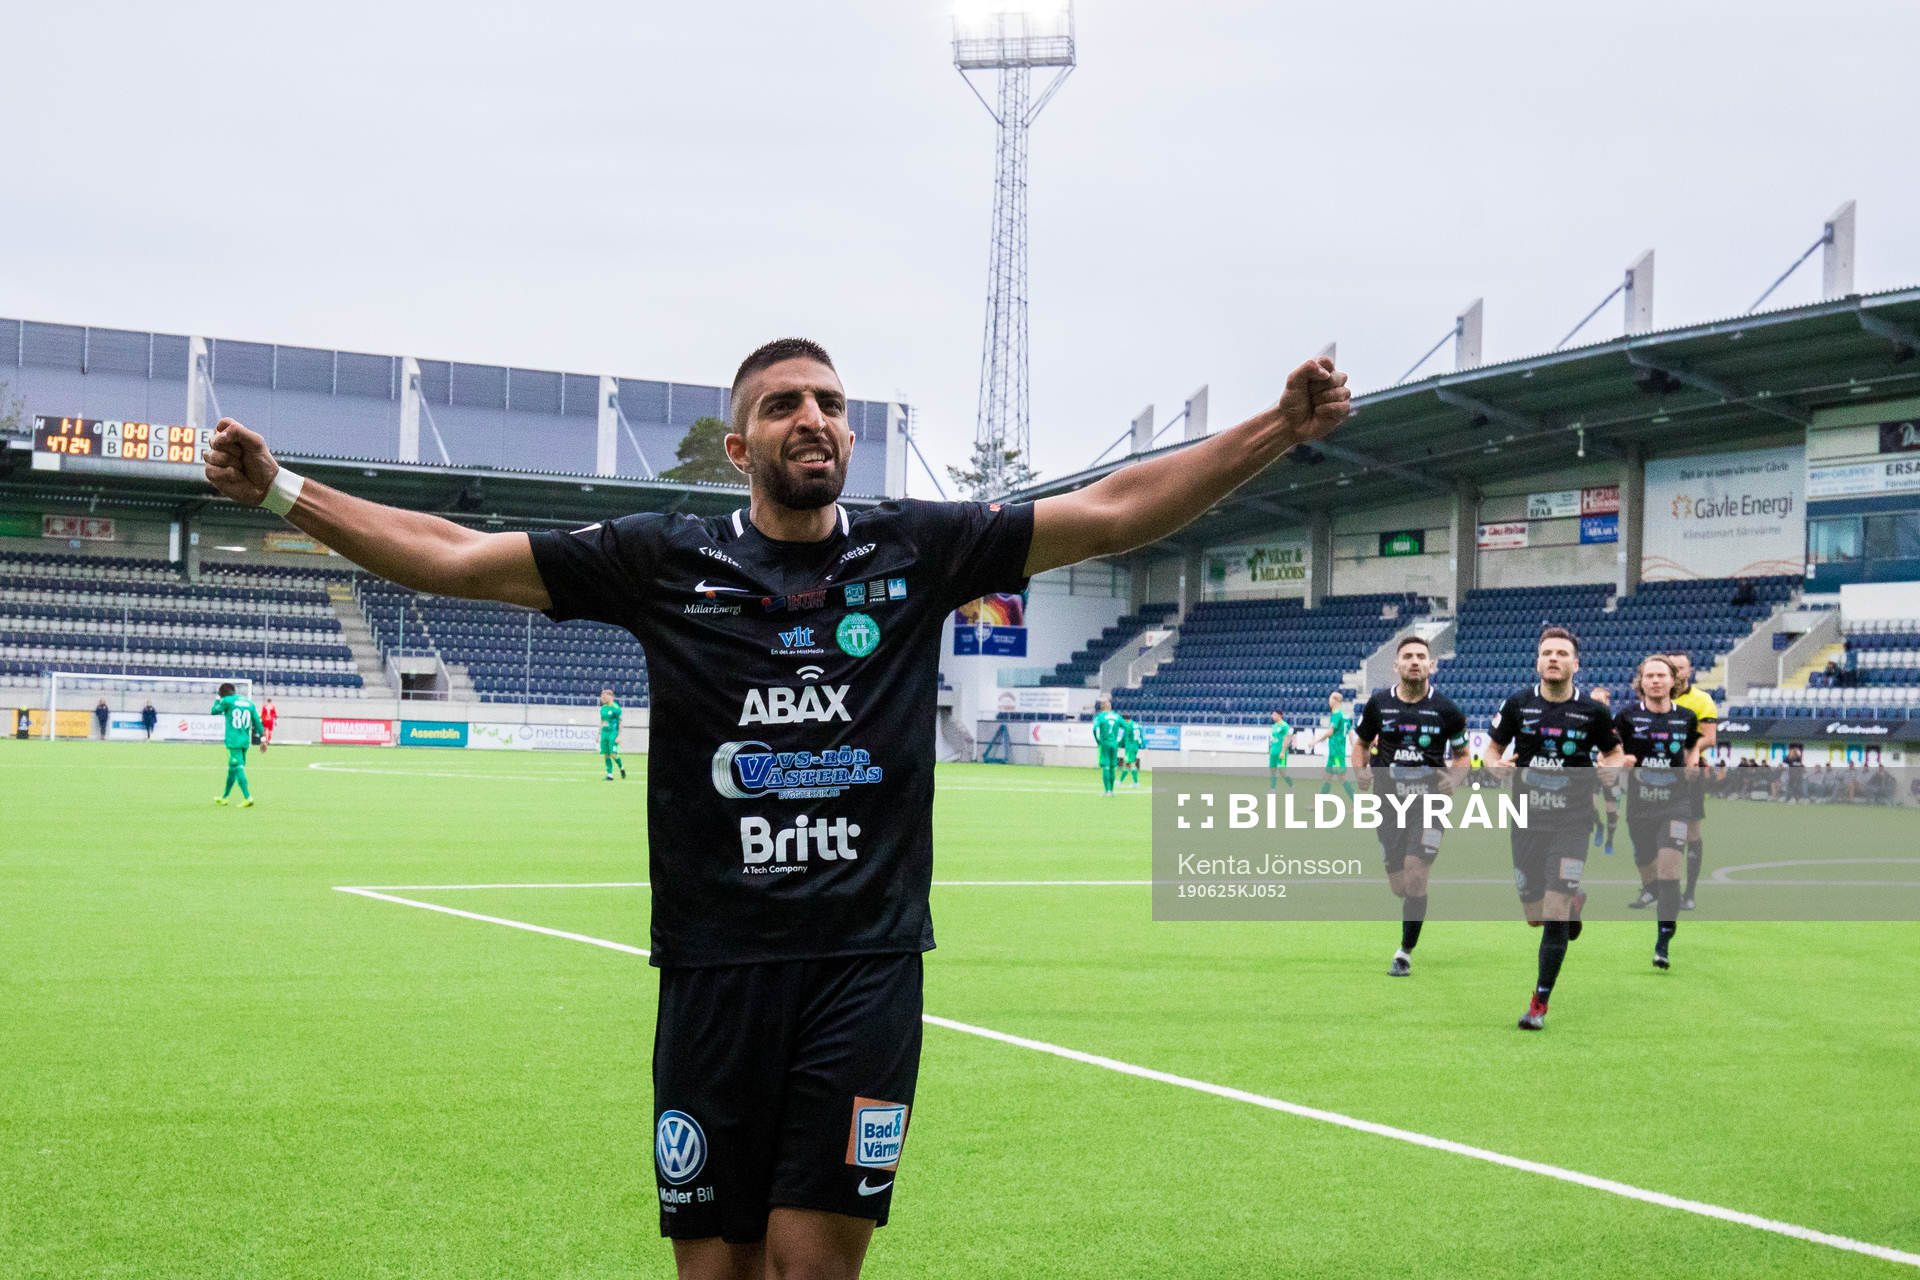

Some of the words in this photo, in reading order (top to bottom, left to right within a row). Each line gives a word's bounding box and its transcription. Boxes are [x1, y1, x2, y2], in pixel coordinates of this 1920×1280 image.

[108, 423, 118, 437] A
[154, 427, 165, 441] C
[107, 441, 117, 454] B
[153, 445, 164, 457] D
[1694, 493, 1739, 519] Gävle
[1741, 490, 1793, 519] Energi
[778, 626, 816, 648] vlt
[738, 685, 853, 726] ABAX
[231, 707, 251, 730] 80
[410, 727, 460, 740] Assemblin
[1393, 749, 1425, 762] ABAX
[1529, 755, 1565, 771] ABAX
[1641, 757, 1672, 769] ABAX
[1529, 789, 1567, 808] Britt
[1640, 785, 1671, 800] Britt
[740, 814, 862, 864] Britt
[742, 865, 750, 875] A
[750, 865, 768, 875] Tech
[768, 864, 809, 876] Company
[864, 1122, 893, 1139] Bad
[863, 1141, 899, 1158] Värme
[696, 1186, 715, 1203] Bil
